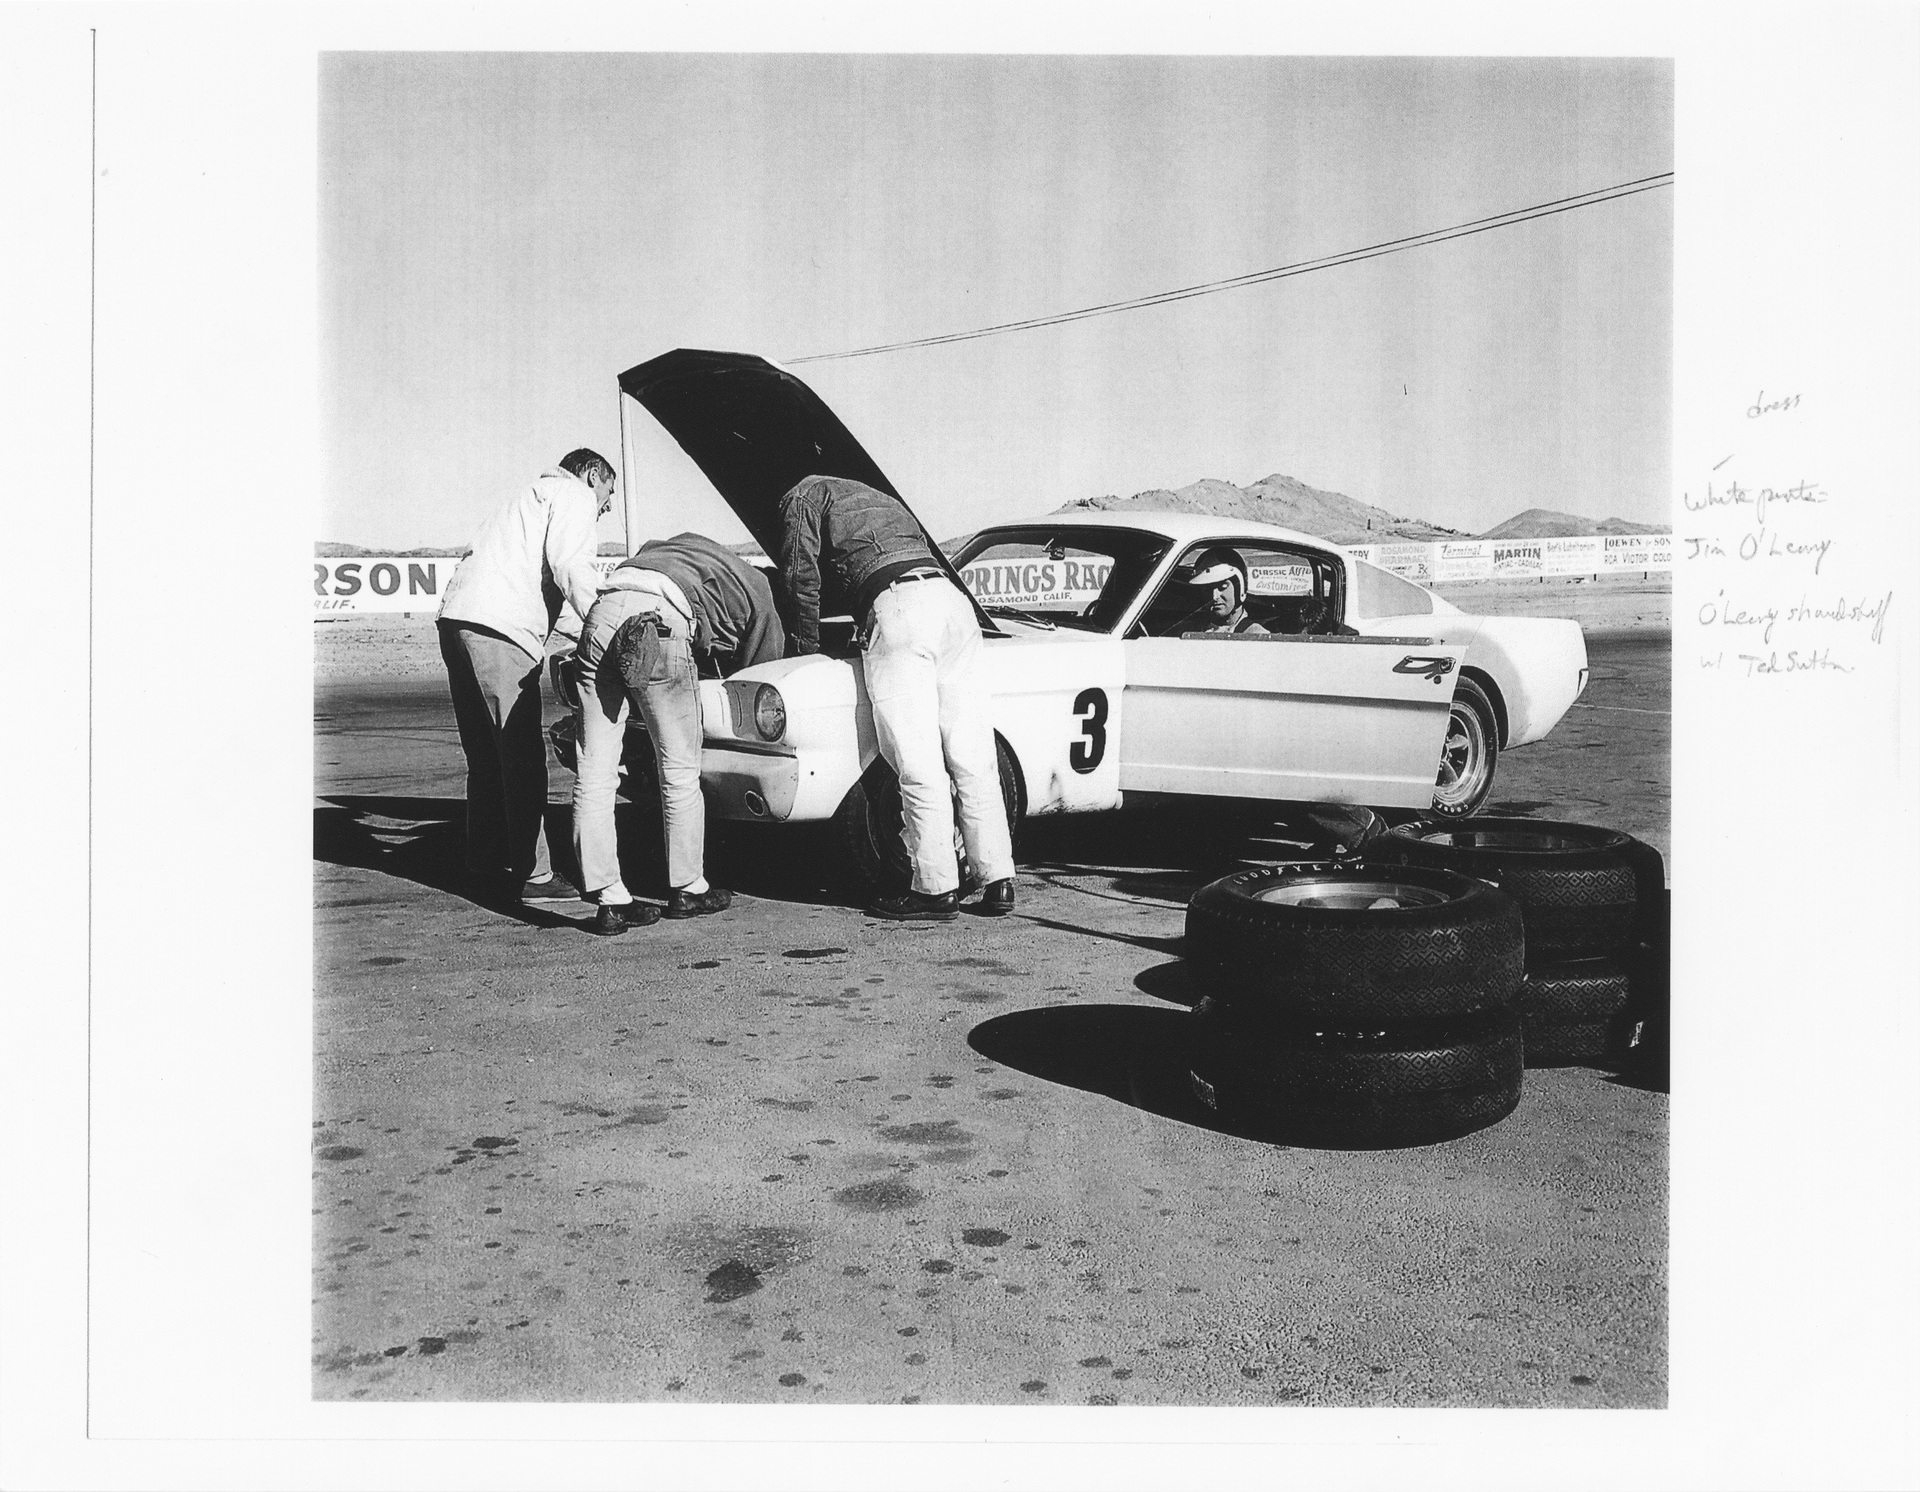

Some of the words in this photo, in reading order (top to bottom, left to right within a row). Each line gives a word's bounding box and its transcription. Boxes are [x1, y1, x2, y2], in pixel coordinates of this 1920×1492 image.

[1348, 550, 1369, 560] ERY
[1441, 544, 1482, 558] Terminal
[1494, 547, 1541, 563] MARTIN
[1684, 538, 1726, 560] Jim
[1252, 568, 1286, 579] CLASSIC
[1289, 566, 1311, 577] AUTO
[1044, 592, 1073, 601] CALIF.
[1739, 652, 1783, 677] Ted
[1069, 687, 1108, 774] 3
[1232, 863, 1365, 885] GOODYEAR
